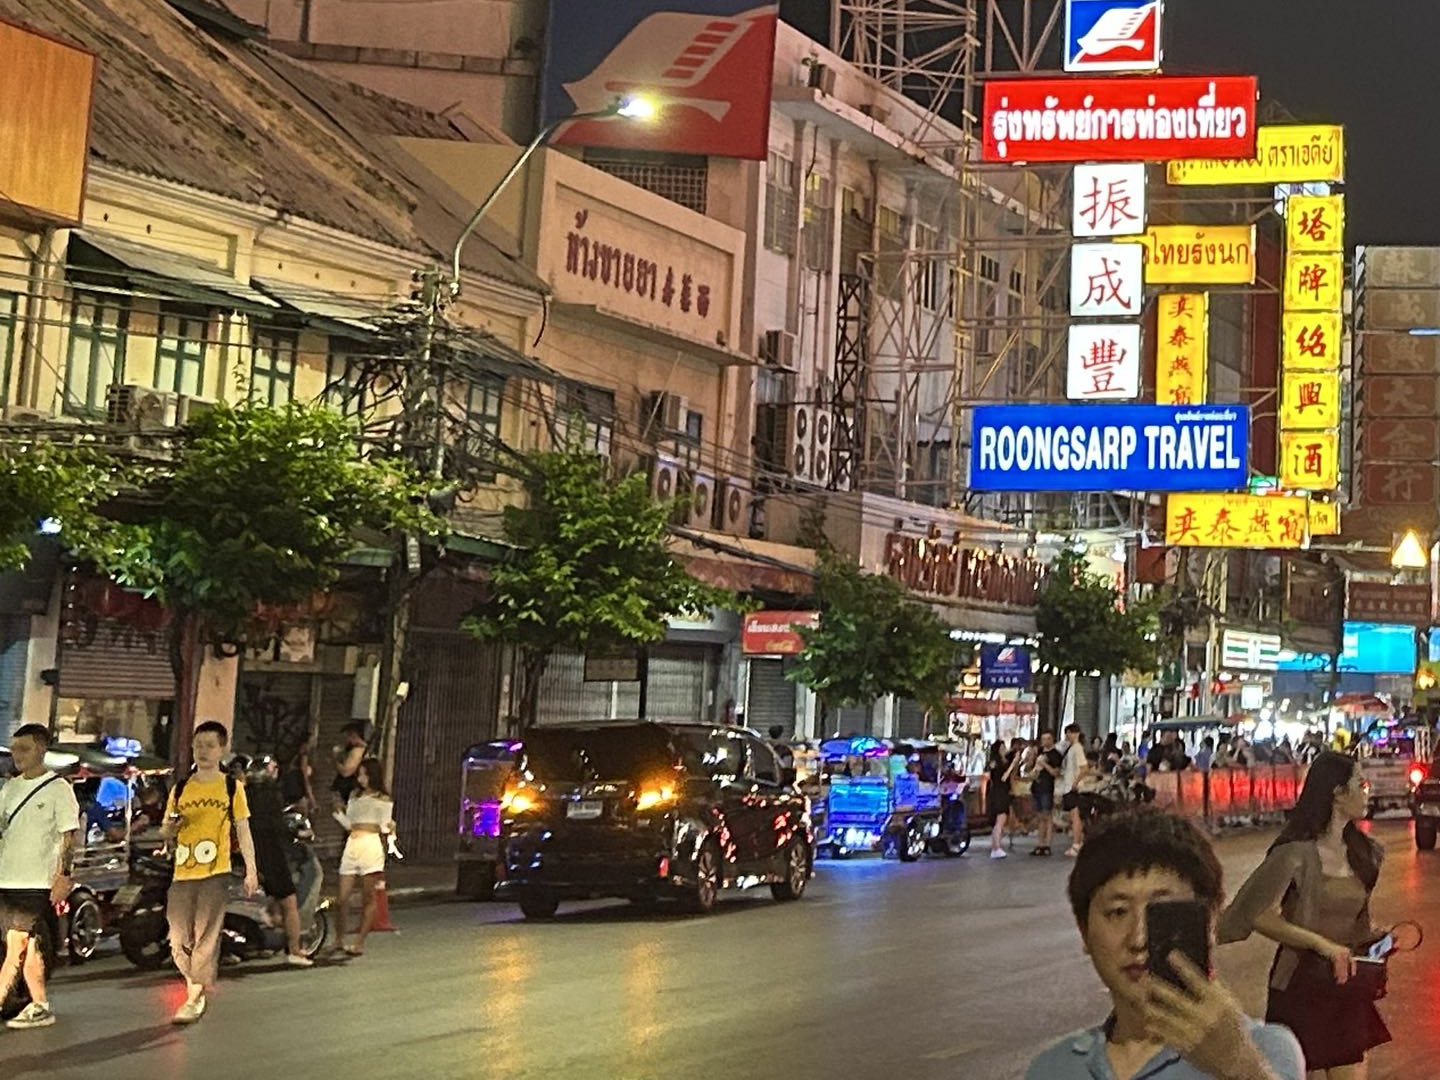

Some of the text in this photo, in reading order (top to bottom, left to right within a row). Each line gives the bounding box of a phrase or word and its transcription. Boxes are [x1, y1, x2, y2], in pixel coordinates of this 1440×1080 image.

[992, 81, 1247, 159] รุ่งทรัพย์การท่องเที่ยว
[979, 424, 1241, 472] ROONGSARP TRAVEL
